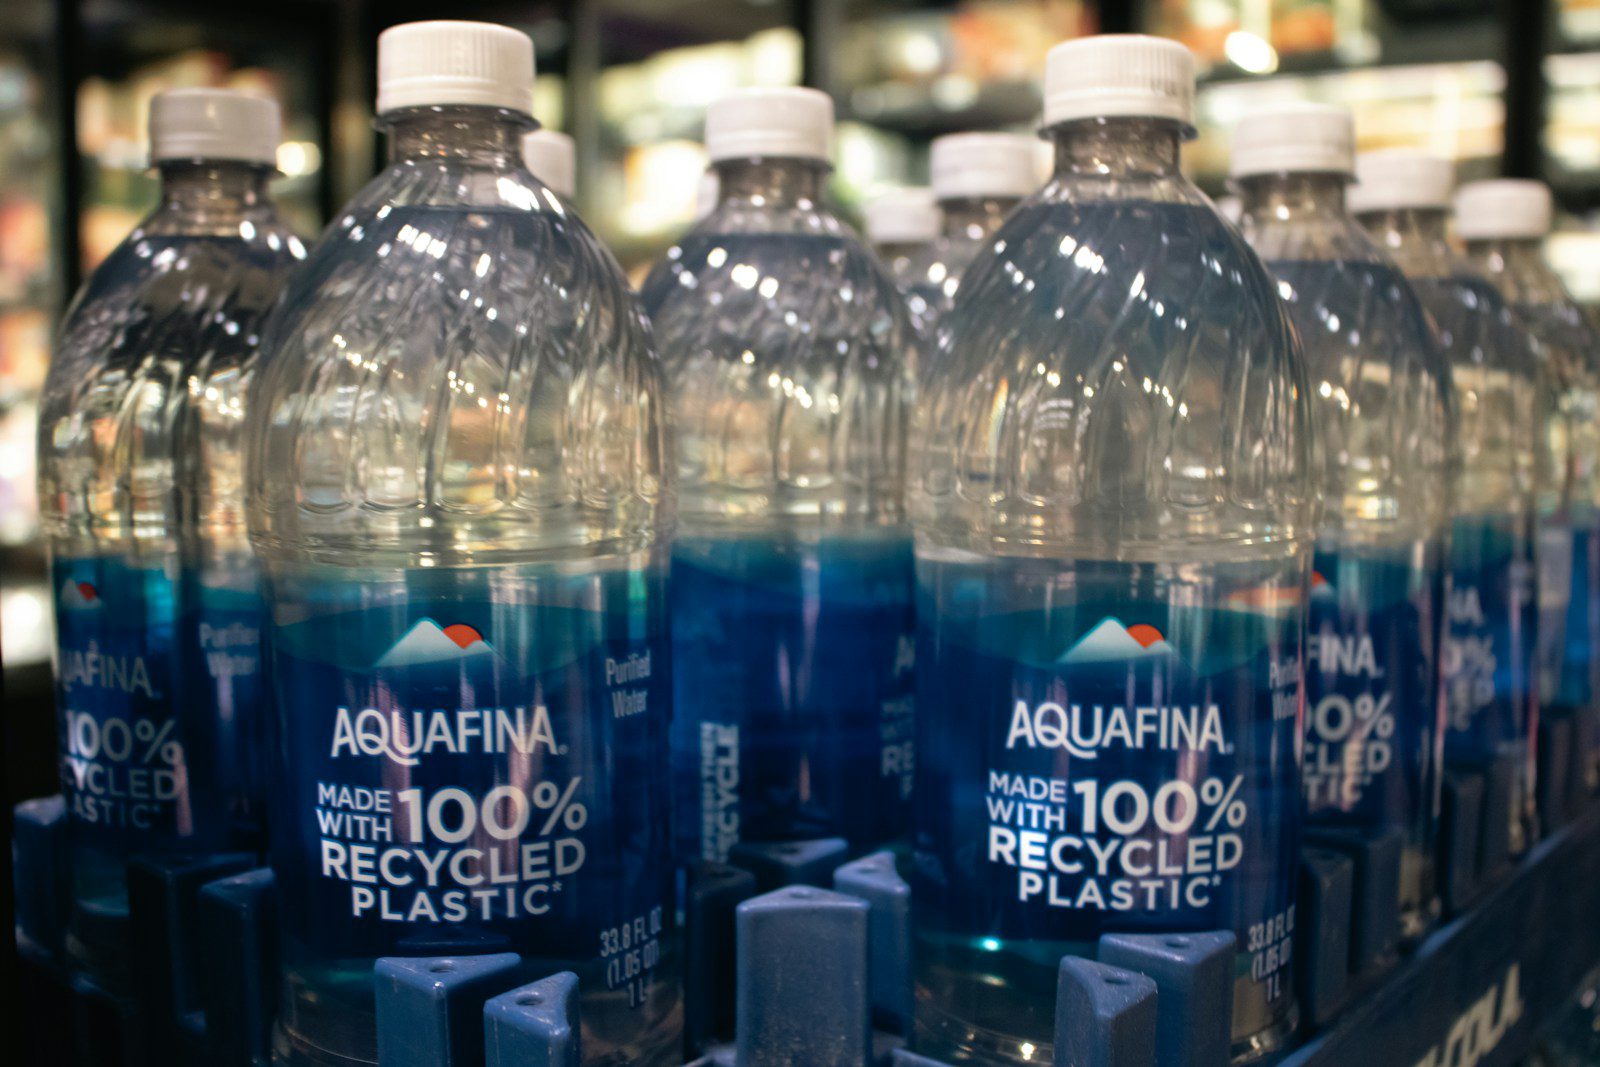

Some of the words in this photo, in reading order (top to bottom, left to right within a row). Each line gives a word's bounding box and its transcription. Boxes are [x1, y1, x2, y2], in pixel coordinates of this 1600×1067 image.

[315, 809, 392, 842] WITH
[317, 782, 392, 813] MADE
[397, 777, 588, 844] 100%
[986, 797, 1066, 831] WITH
[989, 770, 1067, 803] MADE
[1073, 774, 1247, 836] 100%
[321, 838, 586, 887] RECYCLED
[988, 826, 1244, 877] RECYCLED
[600, 923, 631, 958] 33.8
